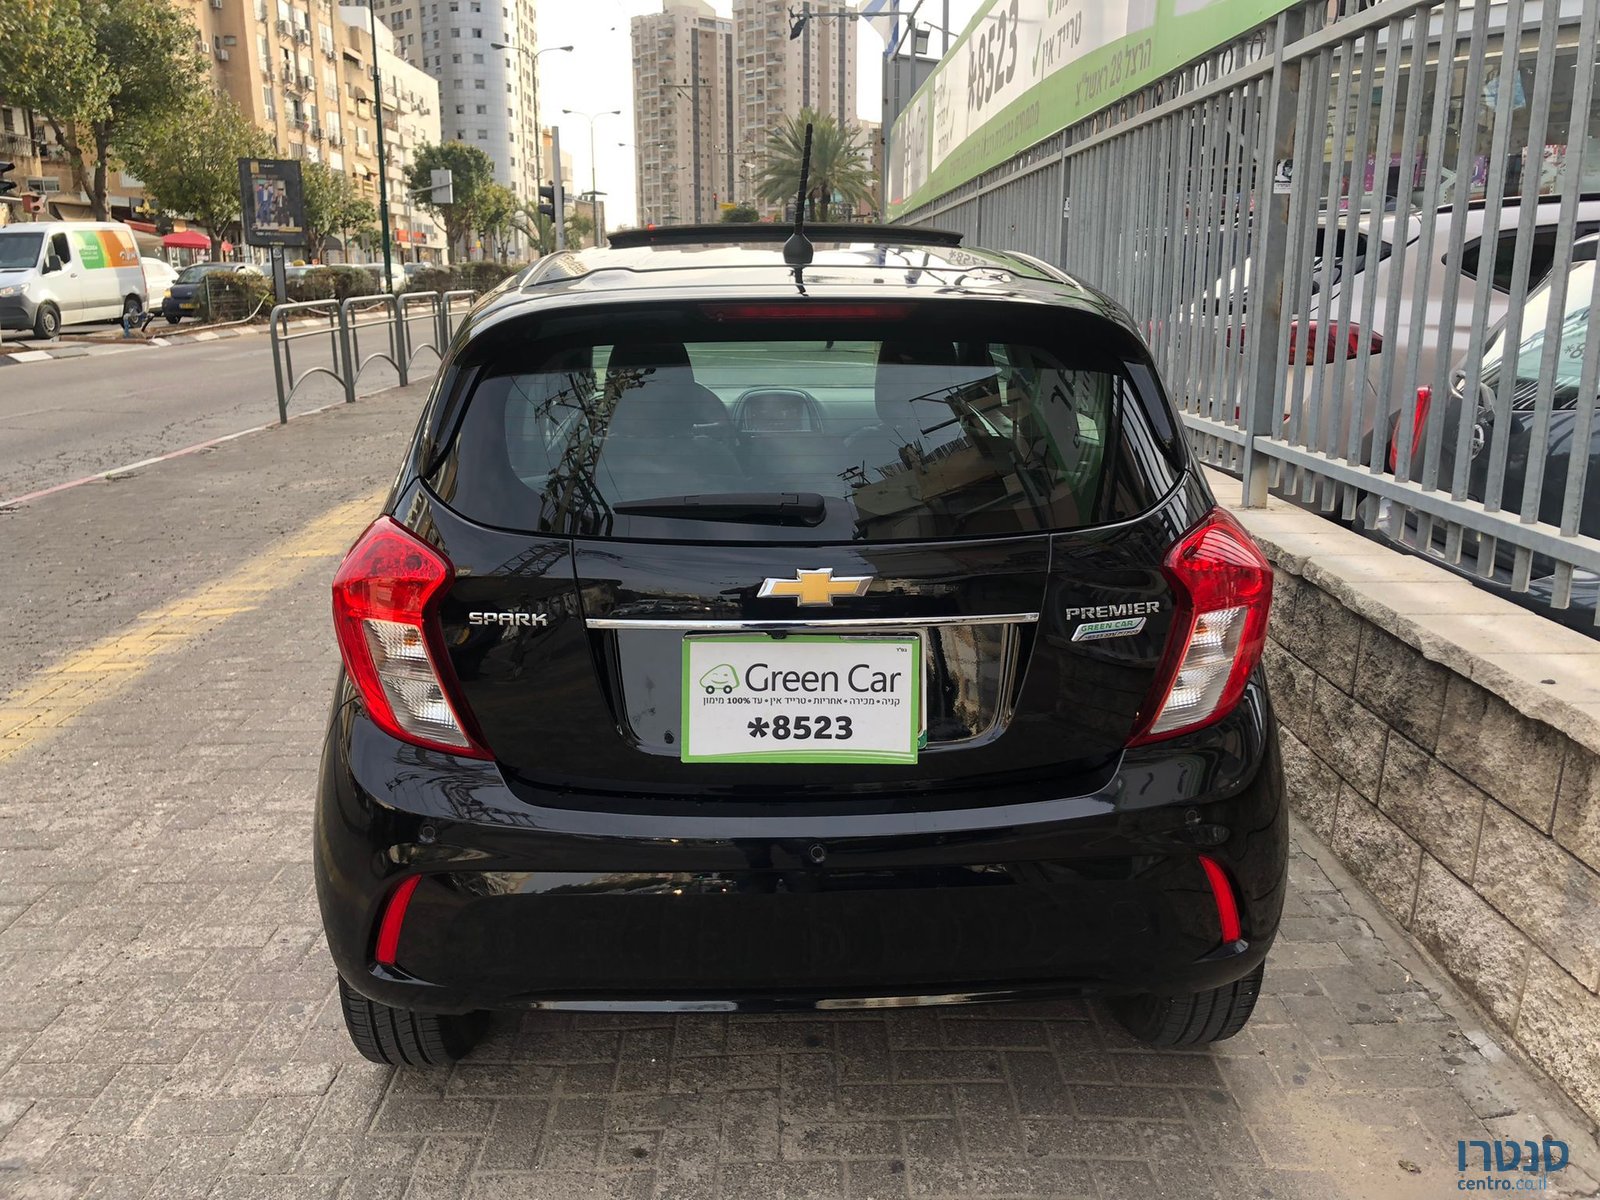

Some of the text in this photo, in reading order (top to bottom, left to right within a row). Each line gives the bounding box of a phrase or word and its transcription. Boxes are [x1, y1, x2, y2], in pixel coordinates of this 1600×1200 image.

[1057, 10, 1082, 58] טרייד
[1041, 34, 1055, 80] אין
[1125, 38, 1152, 79] הרצל
[1109, 50, 1123, 88] 28
[1065, 601, 1160, 620] PREMIER
[469, 612, 547, 626] SPARK
[1081, 620, 1133, 632] GREEN CAR
[745, 663, 902, 693] Green Car
[703, 697, 725, 706] מימון
[770, 697, 782, 706] אין
[785, 697, 807, 705] טרייד
[813, 697, 843, 705] אחריות
[849, 697, 875, 705] מכירה
[881, 697, 900, 707] קניה
